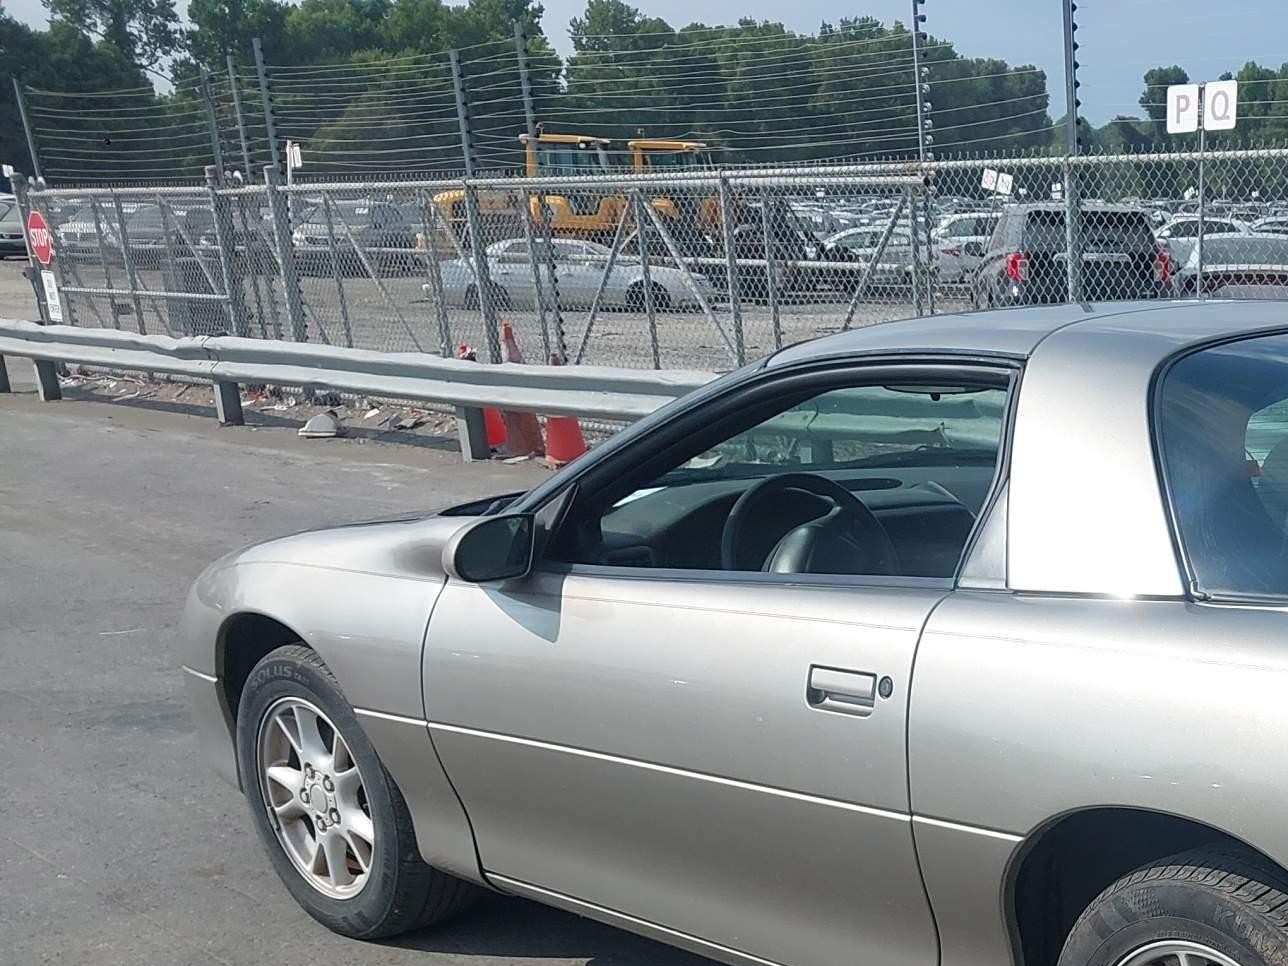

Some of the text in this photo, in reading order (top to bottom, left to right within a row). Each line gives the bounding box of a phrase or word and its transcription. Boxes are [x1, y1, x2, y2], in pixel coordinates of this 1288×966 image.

[1176, 94, 1190, 124] P
[1210, 90, 1231, 121] Q
[30, 228, 48, 247] STOP
